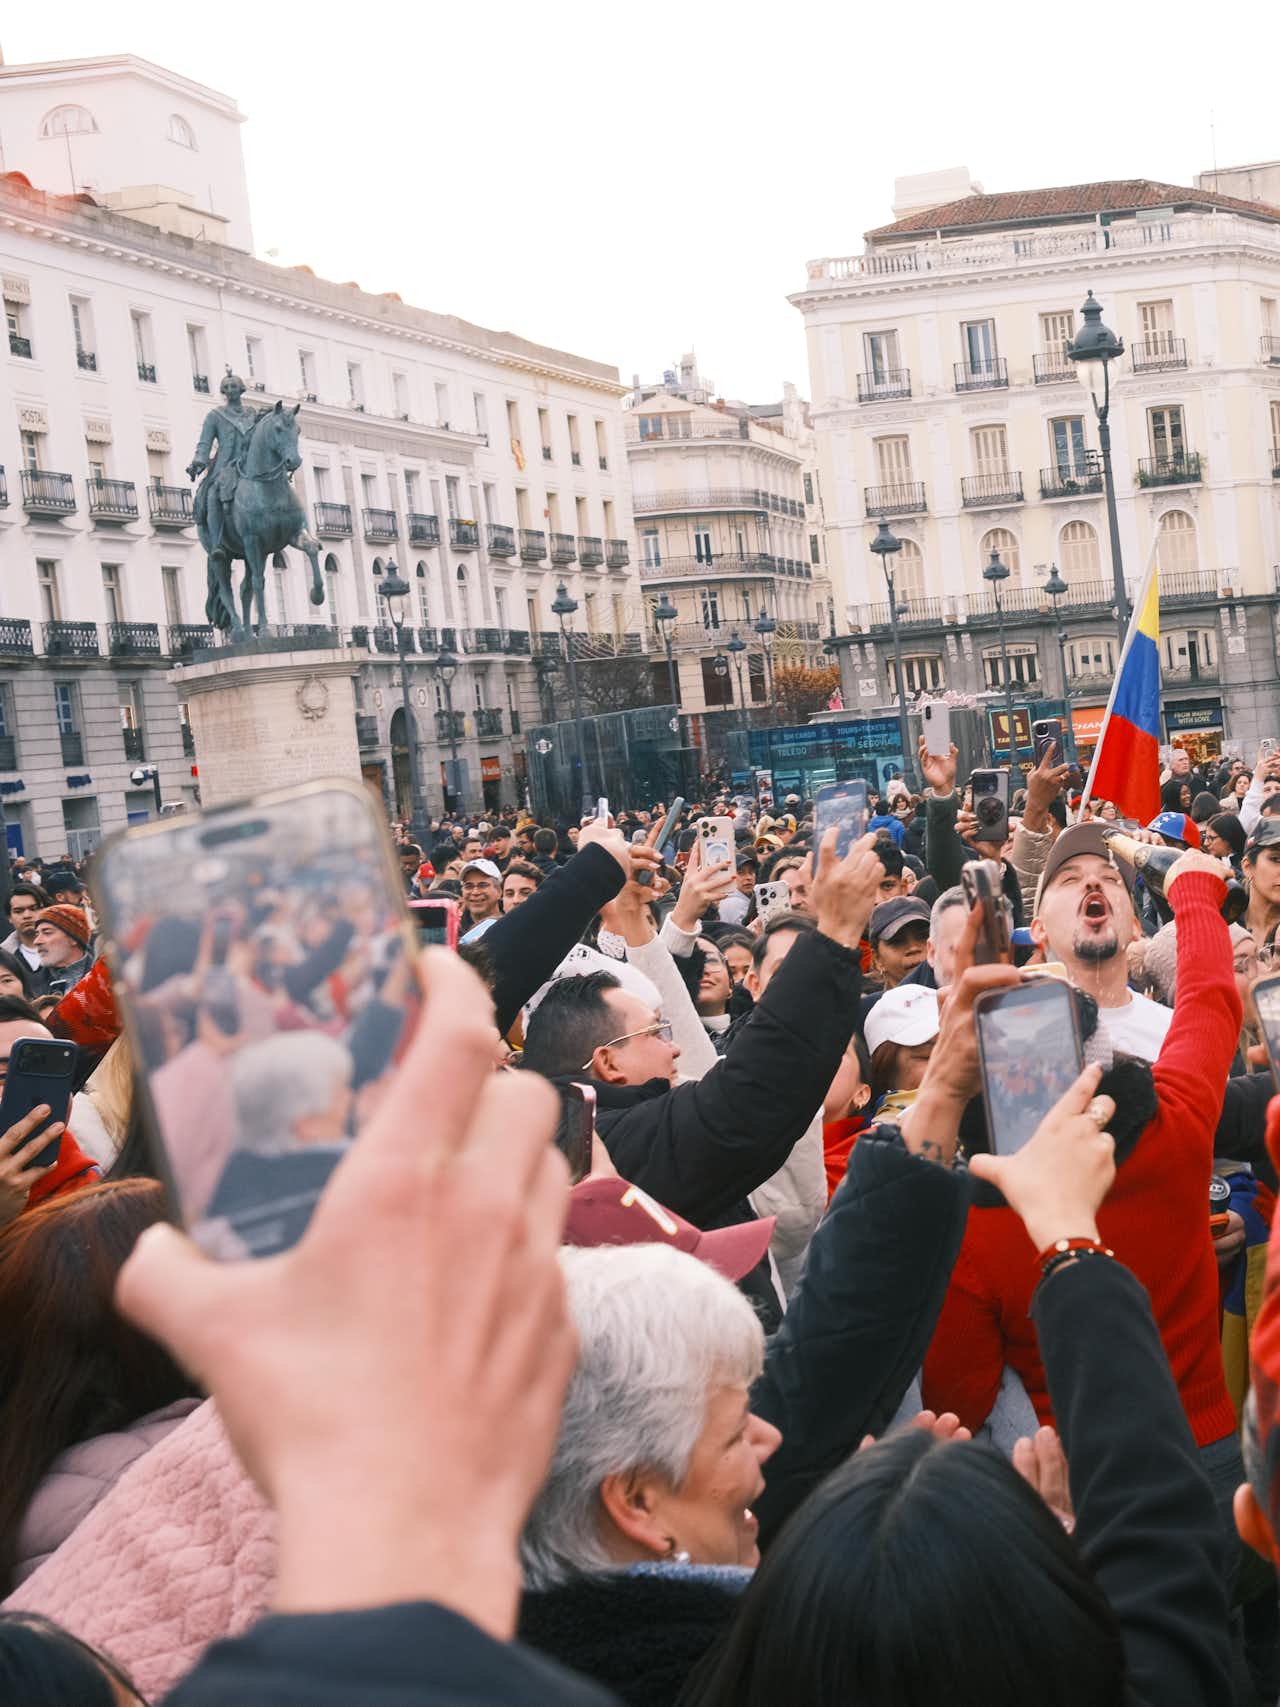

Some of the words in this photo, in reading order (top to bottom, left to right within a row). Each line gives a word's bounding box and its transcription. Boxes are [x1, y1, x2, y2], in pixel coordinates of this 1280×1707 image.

[21, 409, 46, 425] HOSTAL
[987, 649, 1011, 657] DESE
[1174, 711, 1191, 719] FROM
[1192, 709, 1213, 717] MADRID
[1178, 717, 1194, 725] WITH
